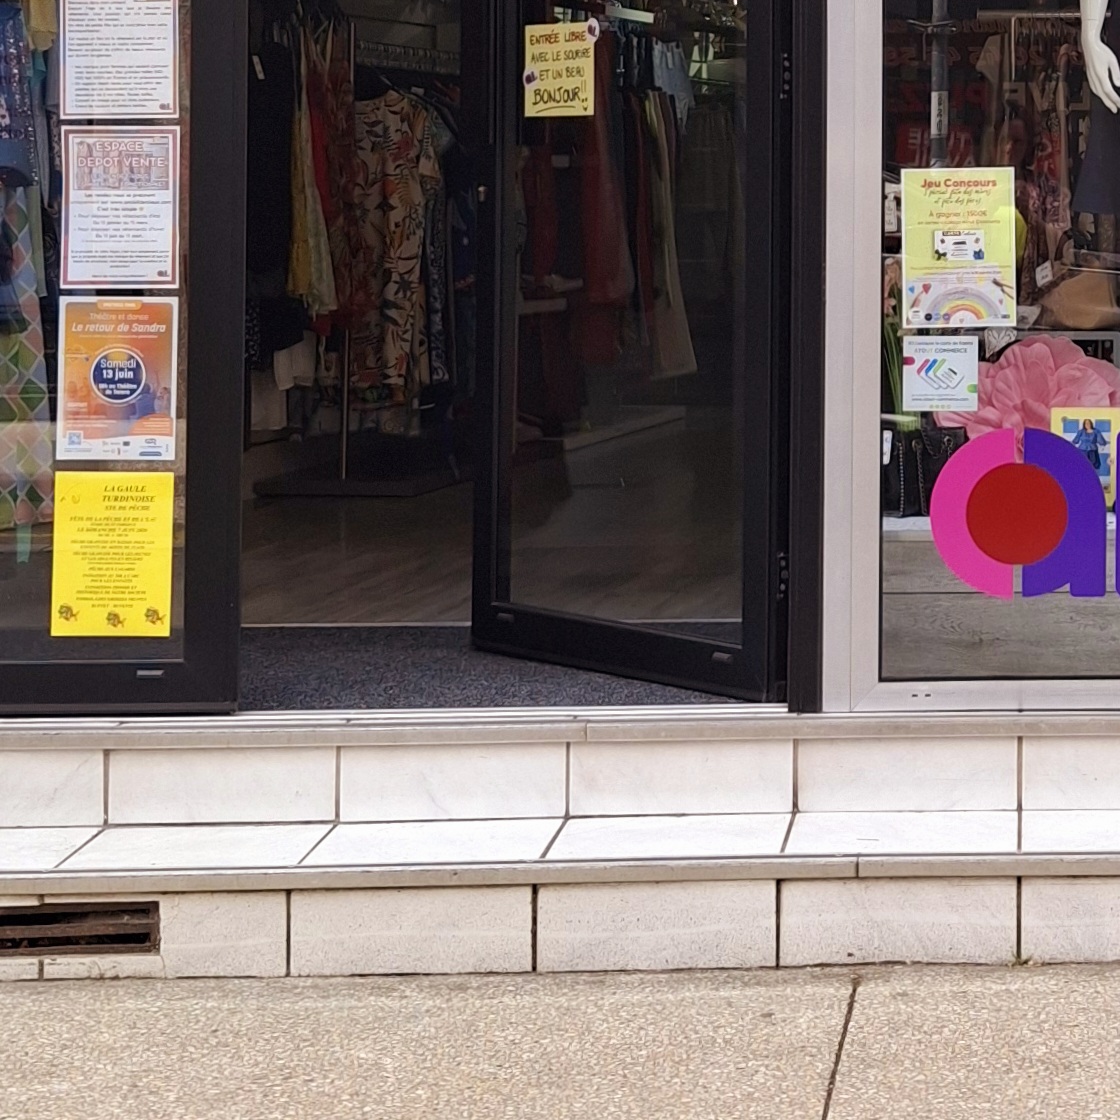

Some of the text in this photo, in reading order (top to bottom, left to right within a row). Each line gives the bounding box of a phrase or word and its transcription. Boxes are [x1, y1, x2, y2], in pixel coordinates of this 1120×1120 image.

[530, 29, 586, 46] ENTRÉE LIBRE
[531, 52, 549, 64] AVEC
[552, 50, 561, 62] LE
[539, 66, 585, 81] ET UN BEAU
[96, 141, 144, 152] ESPACE
[78, 157, 119, 167] DEPOT
[921, 178, 997, 188] Jeu Concours
[72, 323, 166, 332] Le retour de Sandra
[100, 359, 136, 369] Samedi
[102, 369, 134, 381] 13 juin
[104, 485, 146, 493] LA GAULE
[102, 495, 156, 503] TURDINOISE
